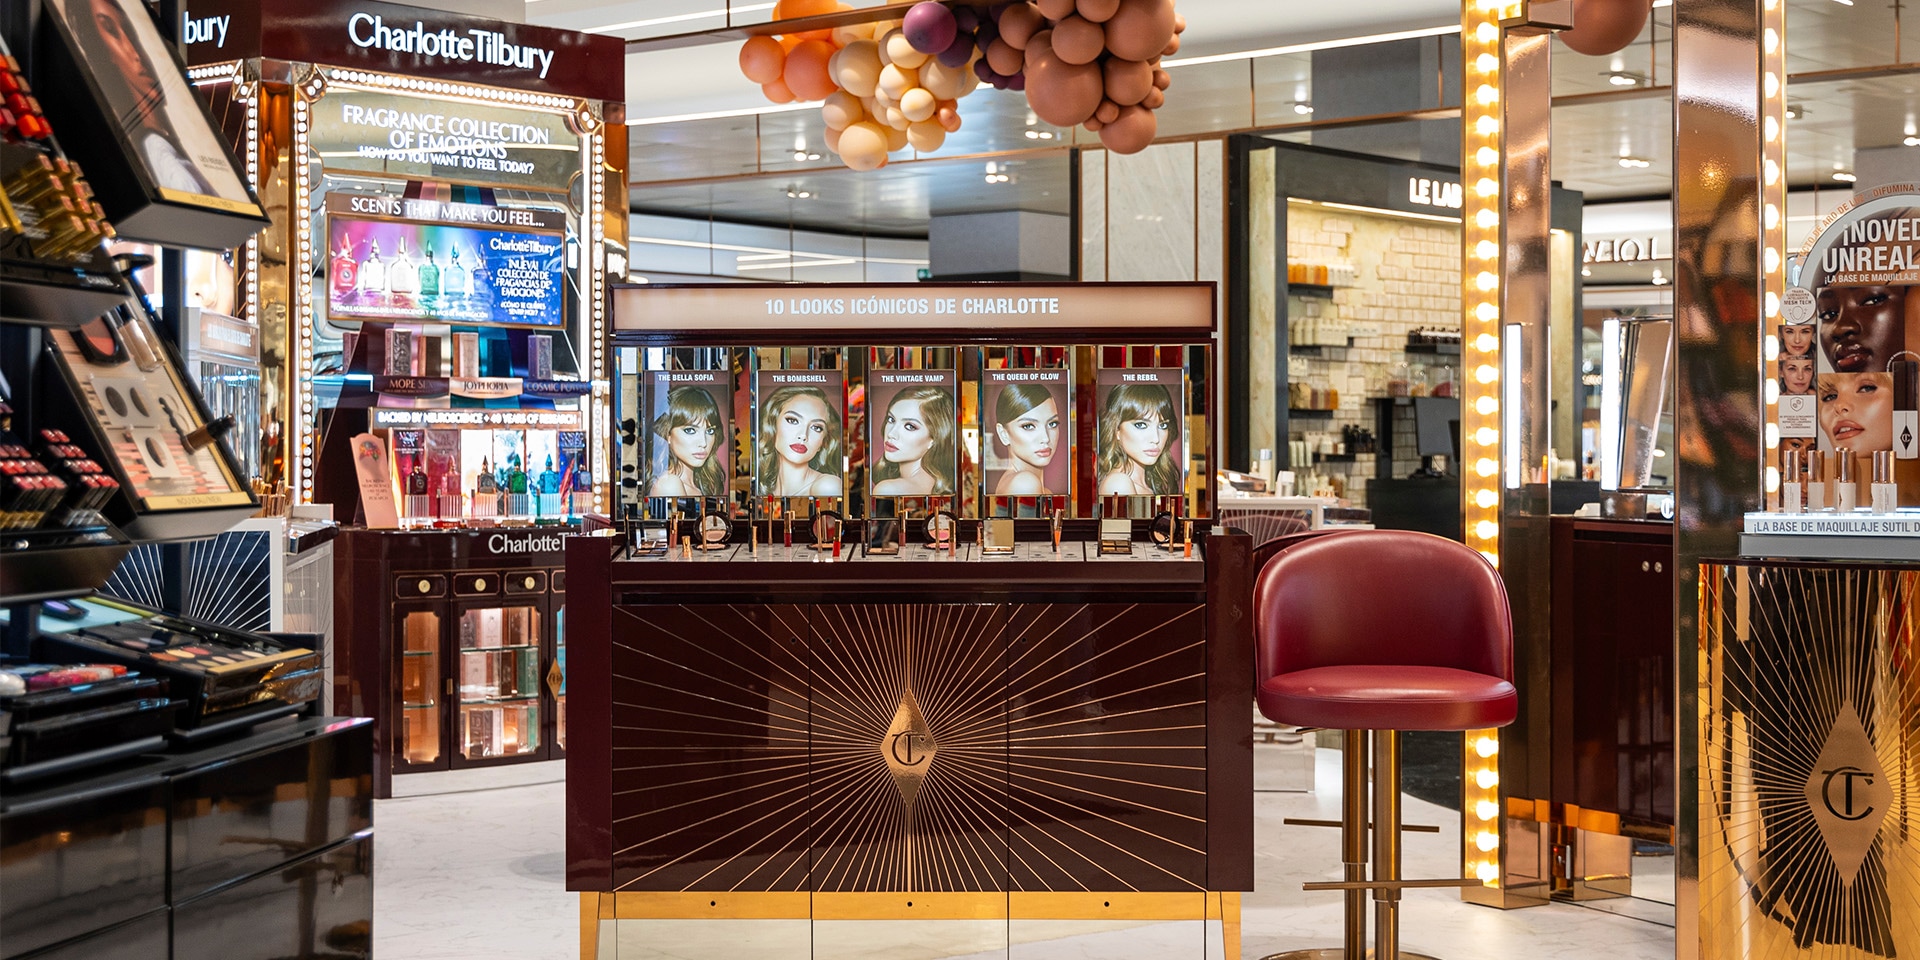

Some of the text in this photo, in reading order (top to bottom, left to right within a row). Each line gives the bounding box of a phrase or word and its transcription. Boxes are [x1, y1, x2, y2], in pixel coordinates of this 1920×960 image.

[348, 12, 554, 79] CharlotteTilbury
[343, 104, 548, 145] FRAGRANCE COLLECTION
[389, 130, 508, 159] OF EMOTIONS
[359, 145, 535, 175] HOW DO YOU WANT TO FEEL TODAY?
[1409, 177, 1431, 205] LE
[1837, 202, 1849, 214] DE
[1873, 184, 1915, 198] DIFUMINA
[351, 197, 545, 228] SCENTS THAT MAKE YOU FEEL...
[1822, 245, 1919, 273] UNREAL
[540, 270, 549, 281] DE
[1824, 272, 1918, 285] ¡LA BASE DE MAQUILLAJE
[496, 277, 540, 289] FRAGANCIAS
[501, 287, 545, 298] EMOCIONES
[765, 295, 1059, 315] 10 LOOKS ICÓNICOS DE CHARLOTTE
[658, 374, 670, 382] THE
[672, 374, 693, 382] BELLA
[773, 375, 786, 383] THE
[882, 375, 944, 383] THE VINTAGE VAMP
[992, 373, 1060, 381] THE QUEEN OF GLOW
[1122, 373, 1159, 381] THE REBEL
[389, 379, 416, 390] MORE
[463, 380, 509, 391] JOYPHORIA
[526, 383, 559, 392] COSMIC
[377, 411, 411, 423] BACKED
[411, 411, 423, 424] BY
[423, 412, 483, 424] NEUROSCIENCE
[502, 413, 526, 424] YEARS
[526, 413, 539, 424] OF
[1753, 521, 1769, 534] ¡LA
[1772, 521, 1798, 532] BASE
[1801, 521, 1813, 532] DE
[1816, 521, 1879, 533] MAQUILLAJE
[1882, 521, 1910, 533] SUTIL
